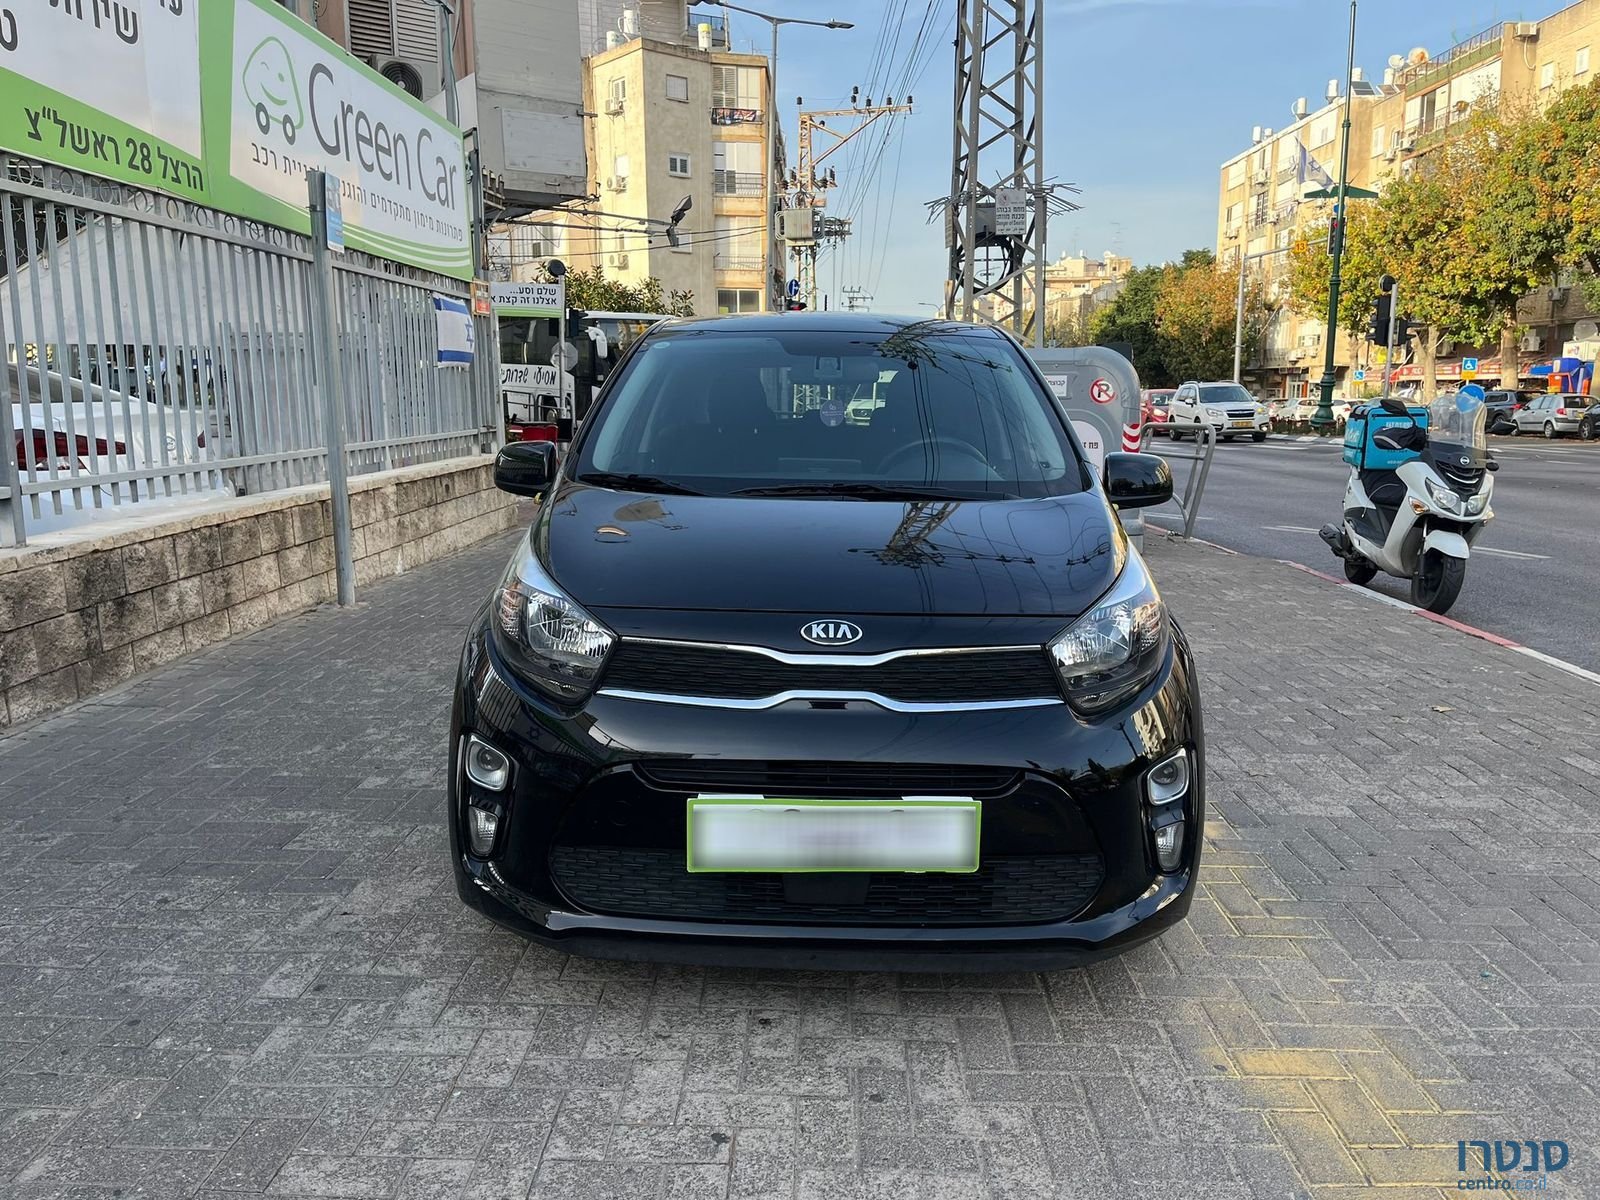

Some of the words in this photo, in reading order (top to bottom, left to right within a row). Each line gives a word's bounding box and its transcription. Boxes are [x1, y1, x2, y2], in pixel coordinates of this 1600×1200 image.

[308, 62, 412, 191] Green
[416, 127, 457, 211] Car
[125, 137, 153, 174] 28
[251, 142, 277, 170] רכב
[156, 145, 204, 191] הרצל
[370, 192, 411, 222] מתקדמים
[413, 210, 434, 231] מימון
[436, 219, 463, 242] פתרונות
[520, 296, 531, 304] זה
[536, 286, 557, 295] שלם
[498, 295, 518, 306] קצת
[532, 296, 557, 305] אצלנו
[502, 367, 529, 384] שדרות
[1088, 441, 1099, 449] פח
[811, 623, 853, 639] KIA
